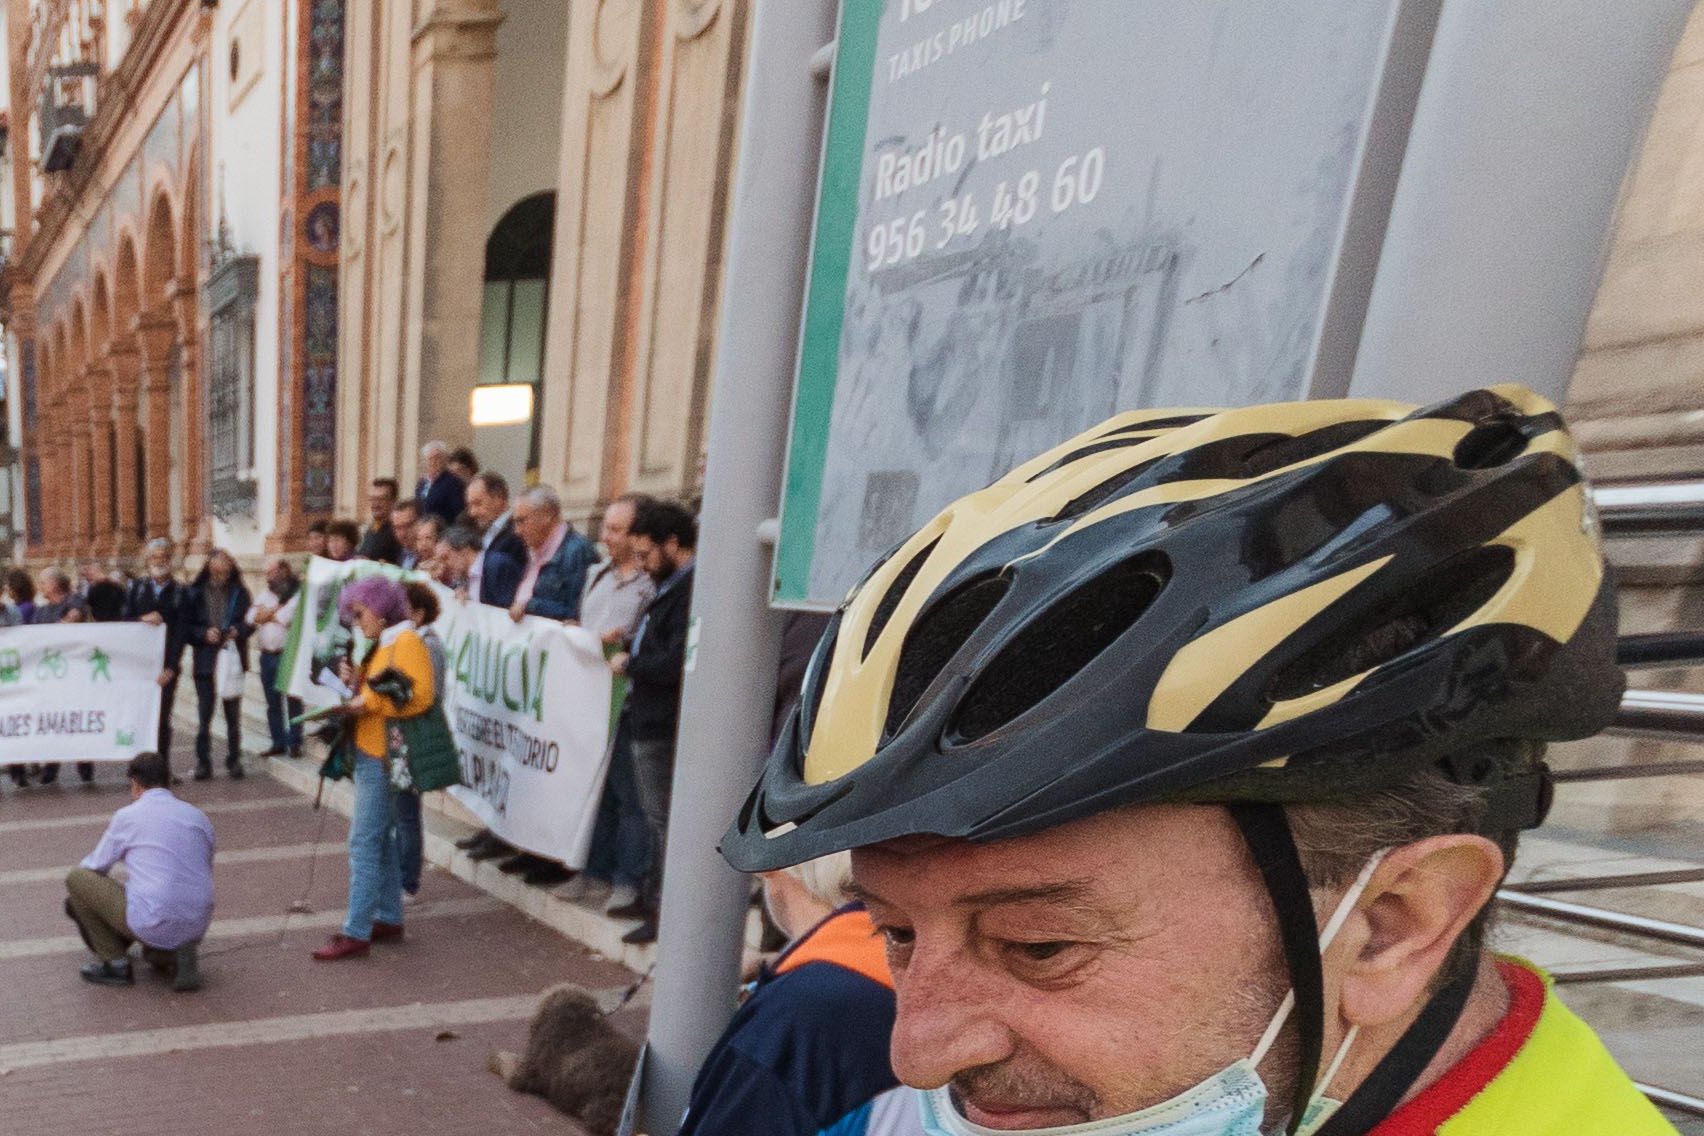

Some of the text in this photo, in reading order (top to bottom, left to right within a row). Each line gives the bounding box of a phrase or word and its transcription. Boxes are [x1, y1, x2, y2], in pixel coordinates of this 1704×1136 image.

[889, 32, 944, 83] TAXIS
[948, 0, 1025, 54] PHONE
[875, 81, 1051, 200] Radio taxi
[868, 147, 1105, 271] 956 34 48 60
